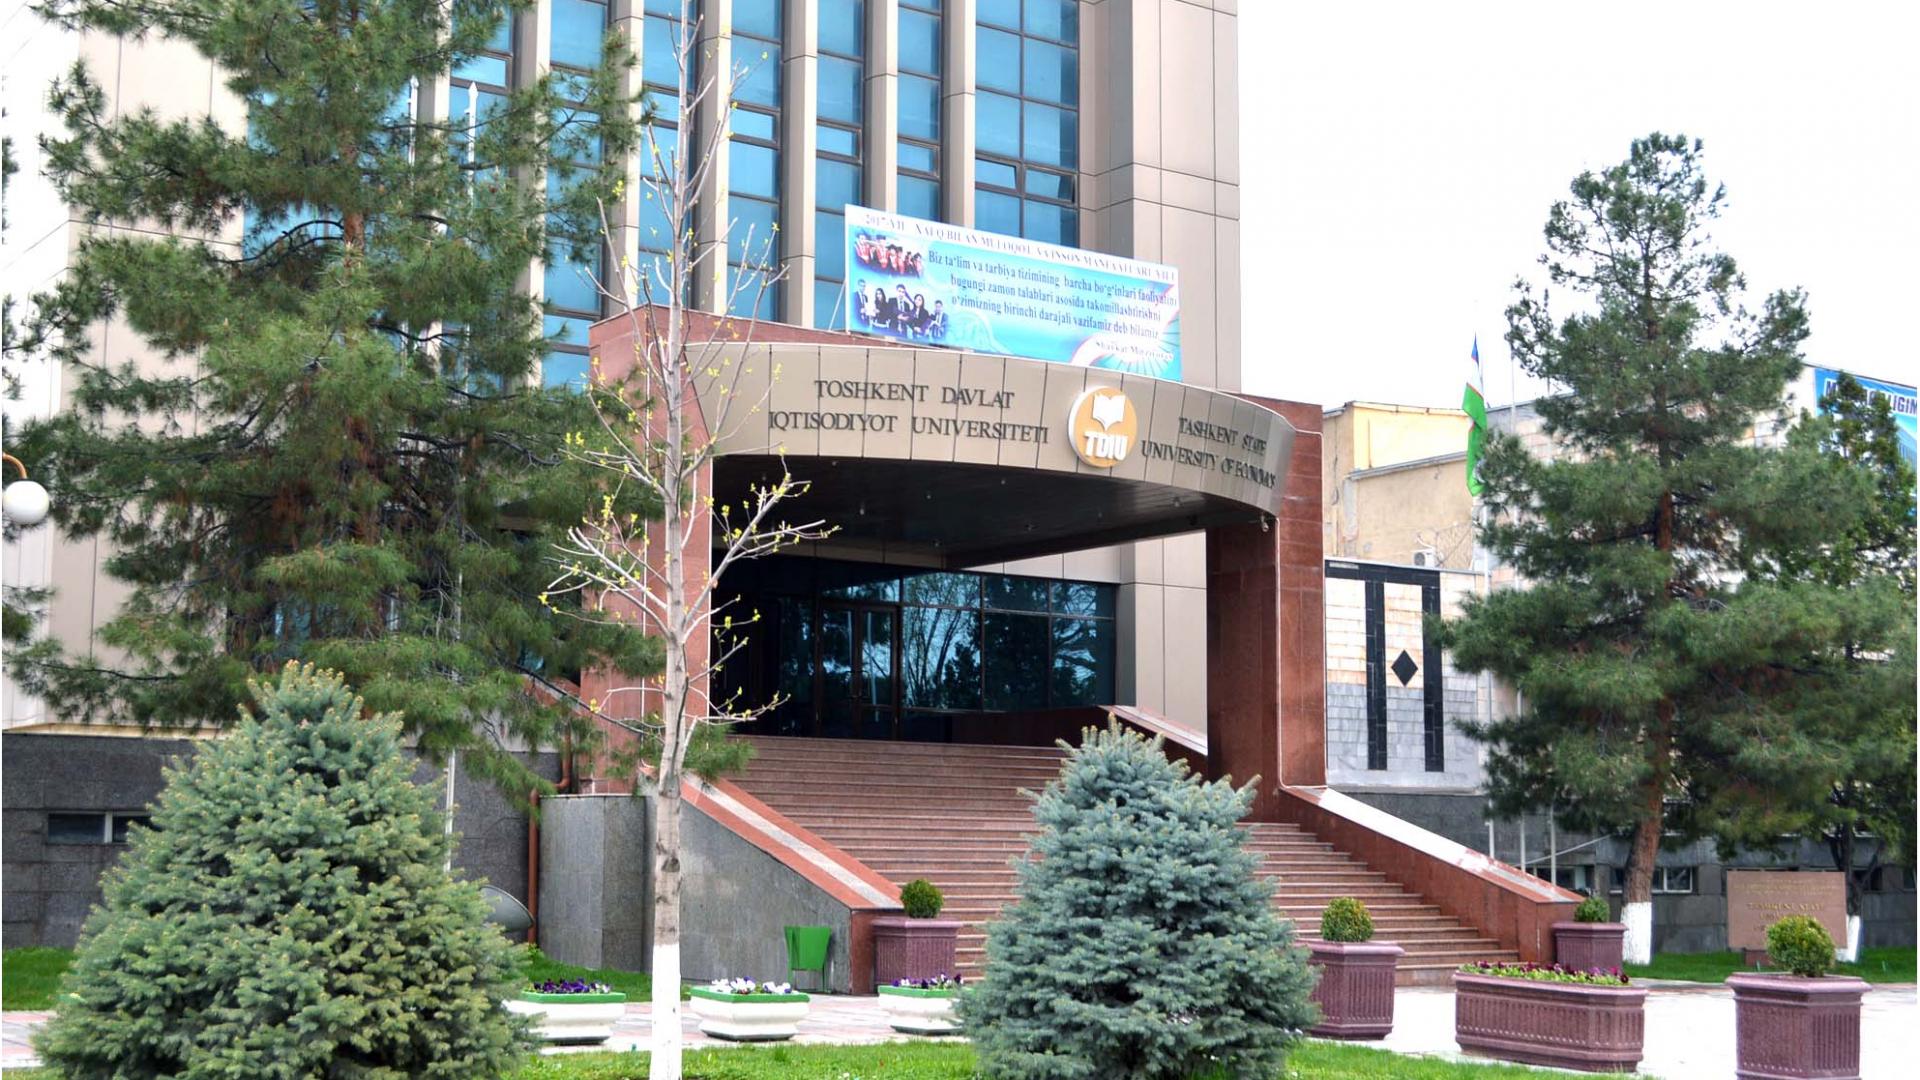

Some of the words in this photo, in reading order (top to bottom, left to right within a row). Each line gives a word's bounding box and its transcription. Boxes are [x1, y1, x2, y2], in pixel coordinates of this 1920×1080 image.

[928, 250, 943, 264] Biz
[973, 260, 983, 271] va
[985, 262, 1016, 280] tarbiya
[1018, 268, 1060, 288] tizimining
[1064, 275, 1092, 291] barcha
[1138, 290, 1177, 307] faoliyatini
[950, 273, 986, 293] bugungi
[988, 283, 1016, 296] zamon
[1017, 286, 1054, 303] talablari
[1055, 295, 1085, 309] asosida
[1087, 299, 1161, 322] takomillashtirishni
[1004, 301, 1037, 319] birinchi
[1039, 307, 1071, 327] darajali
[1073, 314, 1112, 332] vazifamiz
[1113, 322, 1128, 334] deb
[1130, 325, 1159, 340] bilamiz
[814, 380, 929, 402] TOSHKENT
[941, 386, 1015, 409] DAVLAT
[768, 411, 898, 433] IQTISODIYOT
[911, 416, 1049, 444] UNIVERSITETI
[1085, 430, 1129, 461] TDIU
[1178, 416, 1238, 446] TASHKENT
[1242, 434, 1267, 456] STATE
[1141, 440, 1219, 470] UNIVERSITY
[1221, 456, 1235, 474] OF
